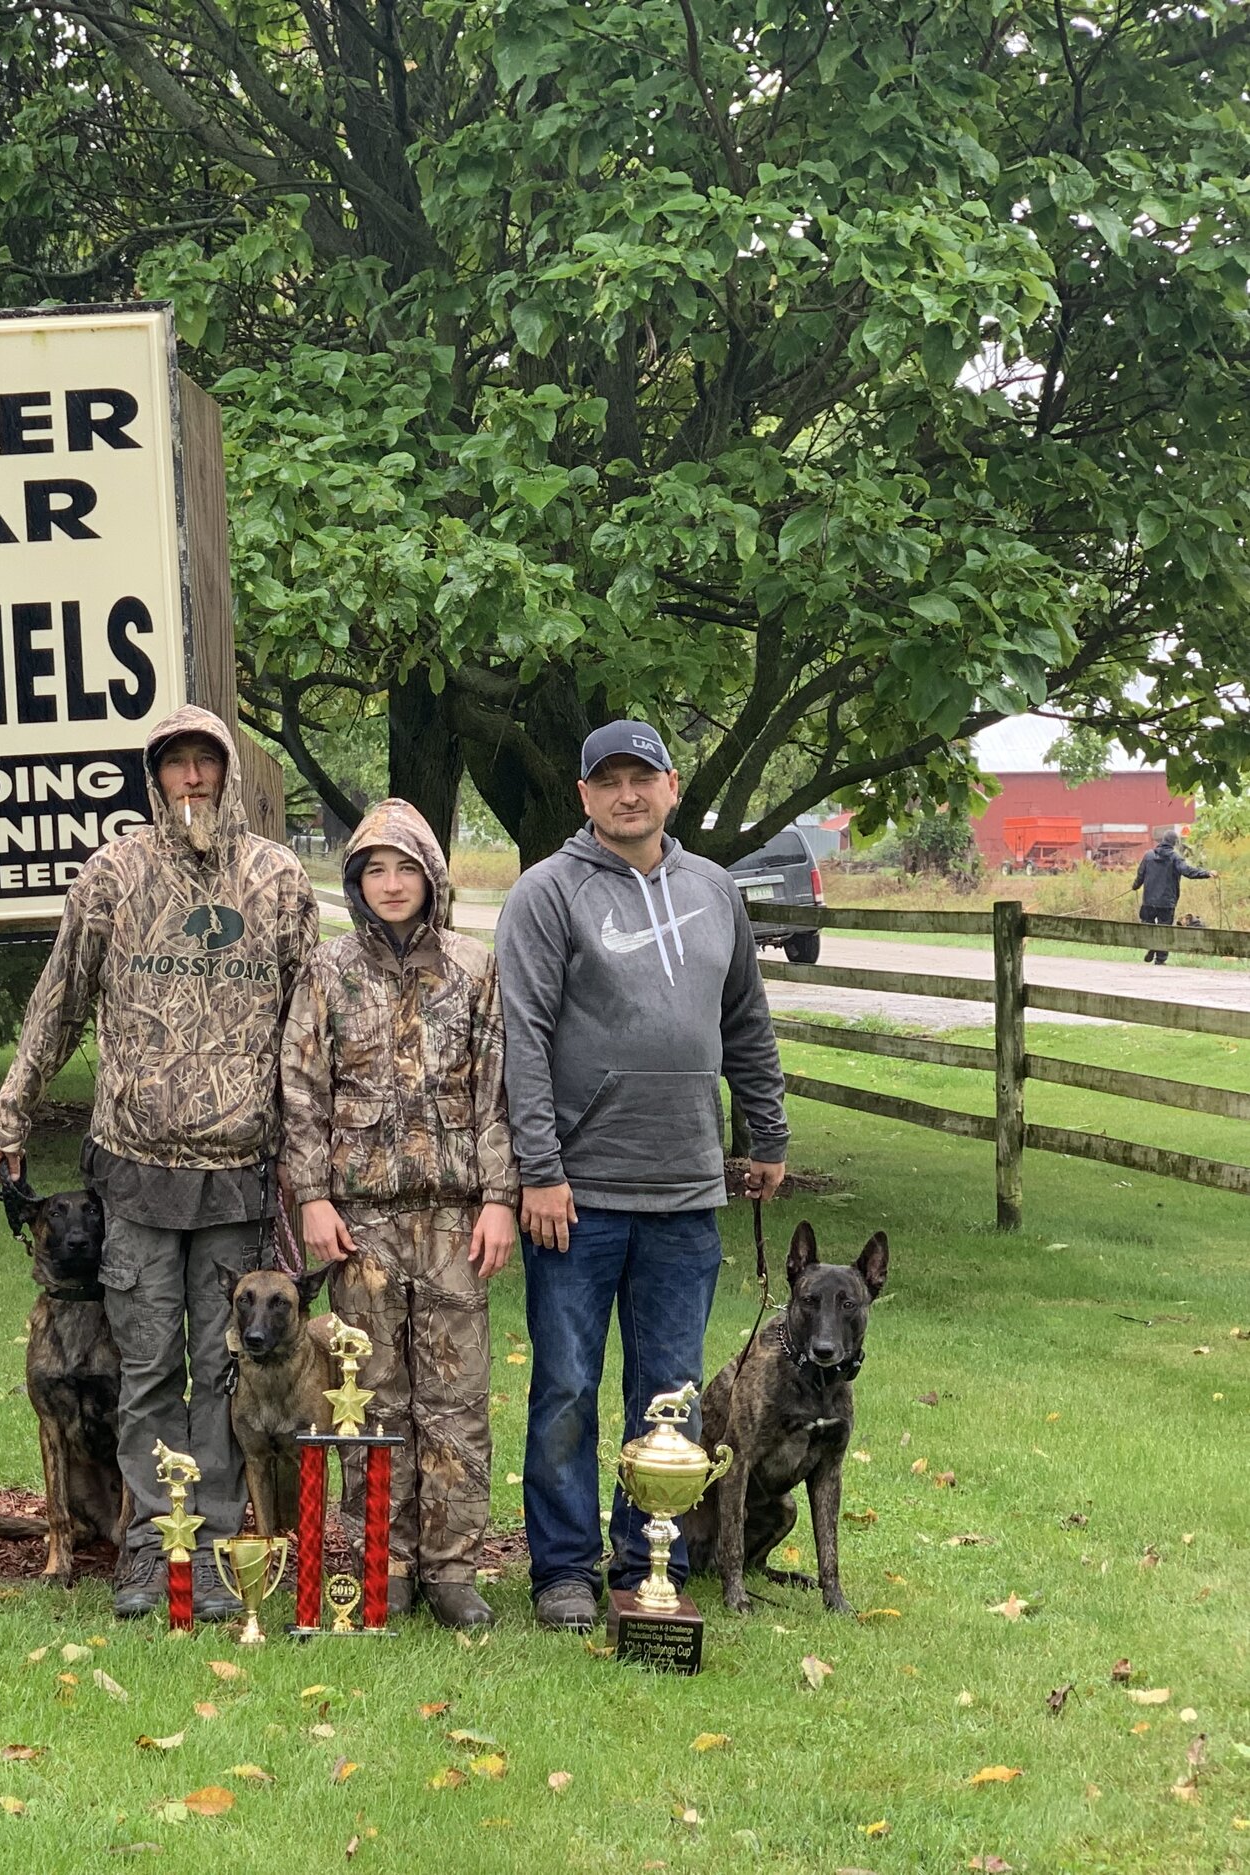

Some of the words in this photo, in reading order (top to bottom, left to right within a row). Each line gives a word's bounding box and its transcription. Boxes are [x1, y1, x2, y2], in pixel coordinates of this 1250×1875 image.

[129, 953, 222, 978] MOSSY
[224, 957, 275, 983] OAK
[331, 1584, 355, 1596] 2019
[659, 1624, 669, 1632] K-9
[670, 1625, 694, 1635] Challenge
[664, 1633, 692, 1642] Tournament
[643, 1642, 676, 1657] Challenge
